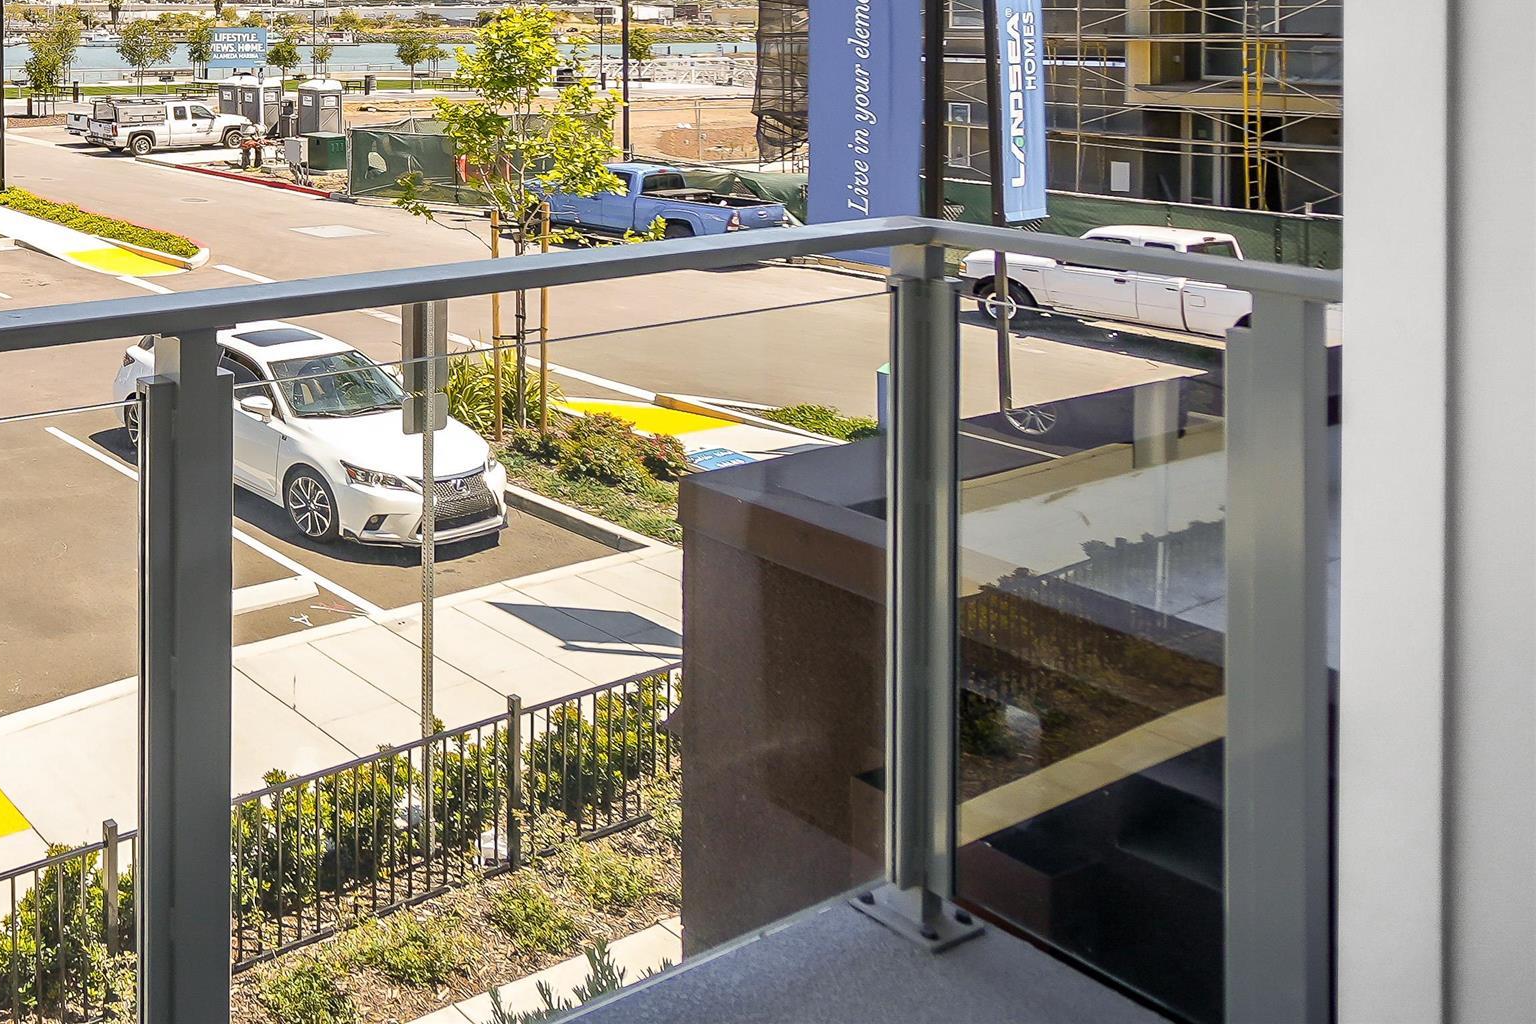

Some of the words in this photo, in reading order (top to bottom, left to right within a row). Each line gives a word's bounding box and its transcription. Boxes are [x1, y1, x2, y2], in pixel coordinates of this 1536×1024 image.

[1023, 11, 1037, 90] HOMES
[855, 64, 877, 125] your
[848, 128, 870, 154] in
[848, 160, 870, 215] Live
